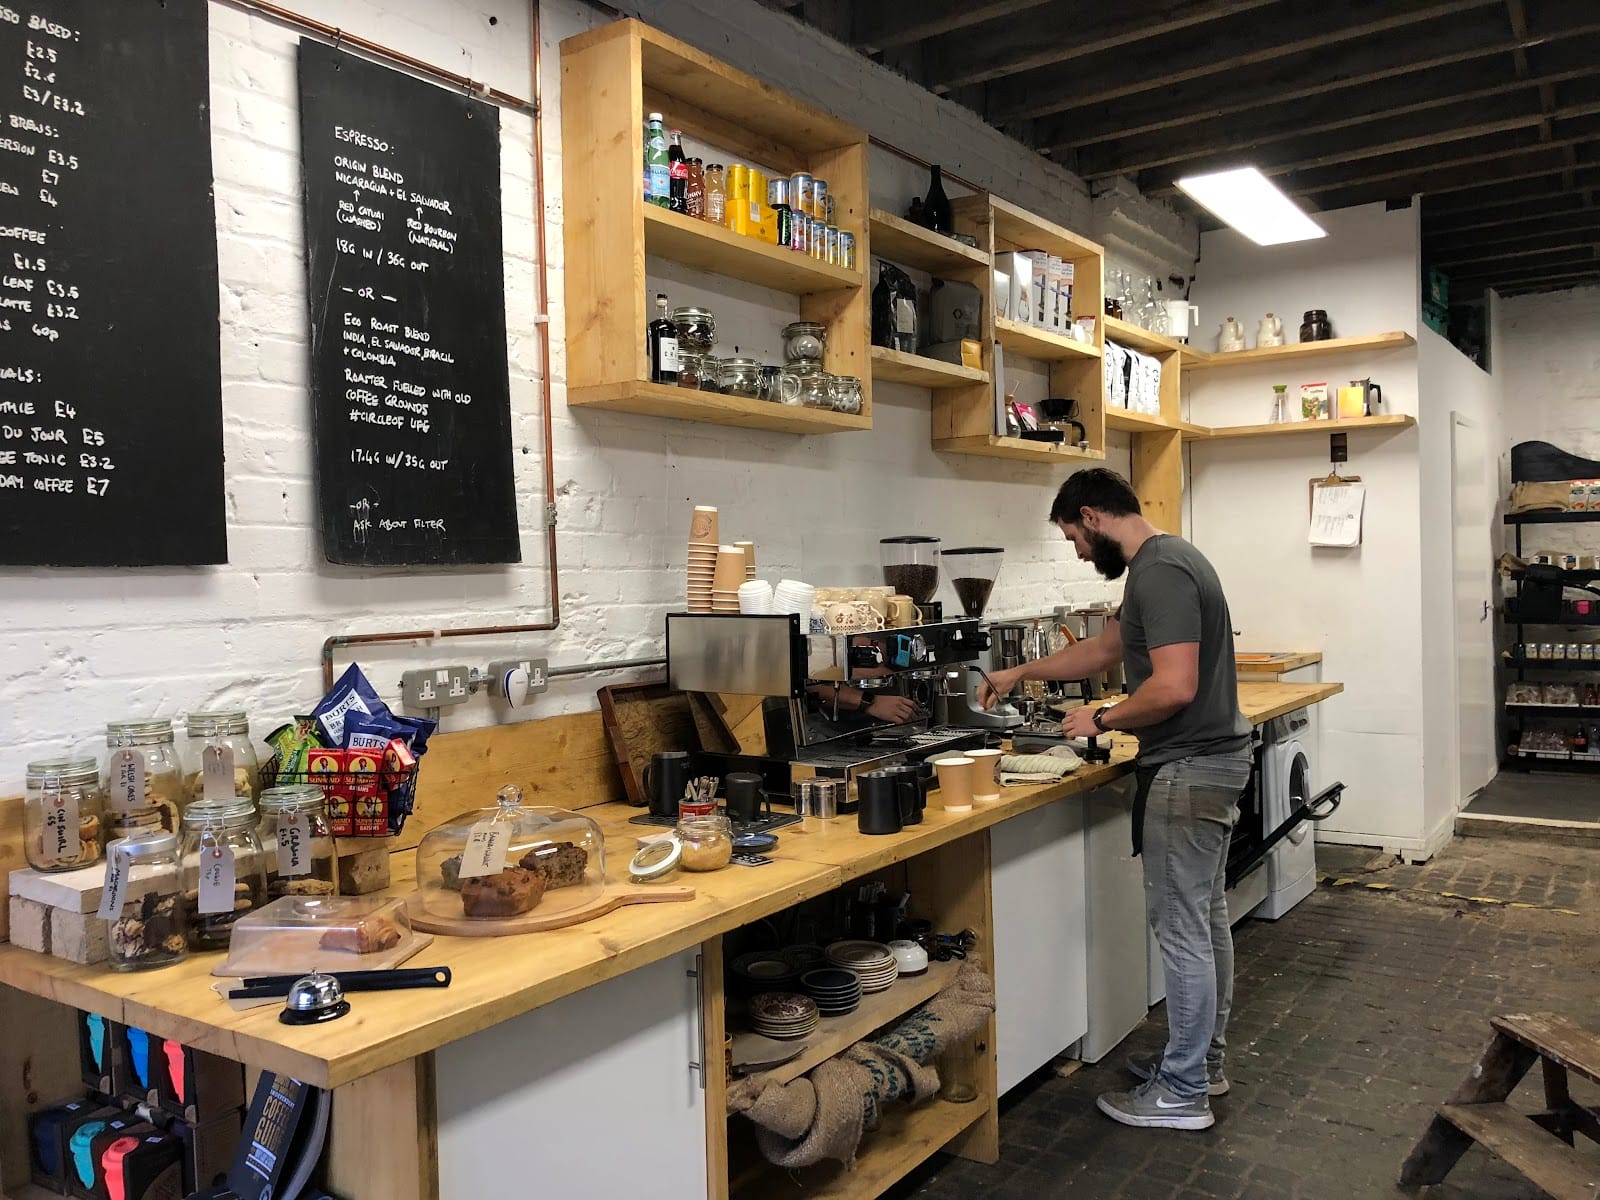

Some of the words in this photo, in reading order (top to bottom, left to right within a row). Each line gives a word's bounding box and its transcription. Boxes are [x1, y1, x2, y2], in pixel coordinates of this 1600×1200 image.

[27, 15, 81, 42] BASED:
[334, 126, 395, 155] ESPRESSO:
[334, 156, 367, 173] ORIGIN
[372, 165, 404, 185] BLEND
[335, 171, 388, 196] NICARAGUA
[396, 188, 407, 201] EL
[410, 192, 453, 216] SALVADOR
[338, 199, 355, 213] RED
[358, 205, 385, 221] CATUAI
[406, 217, 422, 231] RED
[423, 222, 458, 242] BOURBON
[408, 229, 454, 255] (NATURAL)
[336, 237, 356, 255] 18G
[362, 247, 373, 260] IN
[387, 251, 406, 269] 36G
[410, 260, 430, 273] OUT
[2, 275, 34, 292] LEAF
[370, 317, 400, 334] ROAST
[404, 326, 431, 342] BLEND
[371, 336, 382, 348] EL
[423, 348, 455, 364] BRAZIL
[343, 367, 389, 389] ROASTER
[392, 380, 426, 397] FUELLED
[432, 388, 452, 401] WITH
[455, 393, 472, 405] OLD
[0, 401, 36, 415] THIE
[345, 388, 380, 407] COFFEE
[384, 394, 429, 417] GROUNDS
[2, 425, 23, 439] DU
[31, 427, 68, 445] JOUR
[22, 451, 66, 467] TONIC
[429, 459, 449, 471] OUT
[33, 477, 74, 494] COFFEE
[353, 519, 373, 532] ASK
[378, 518, 408, 532] ABOUT
[413, 518, 447, 533] FILTER
[325, 694, 356, 721] BURTS
[352, 737, 386, 751] BURTS
[127, 763, 136, 783] WELSH
